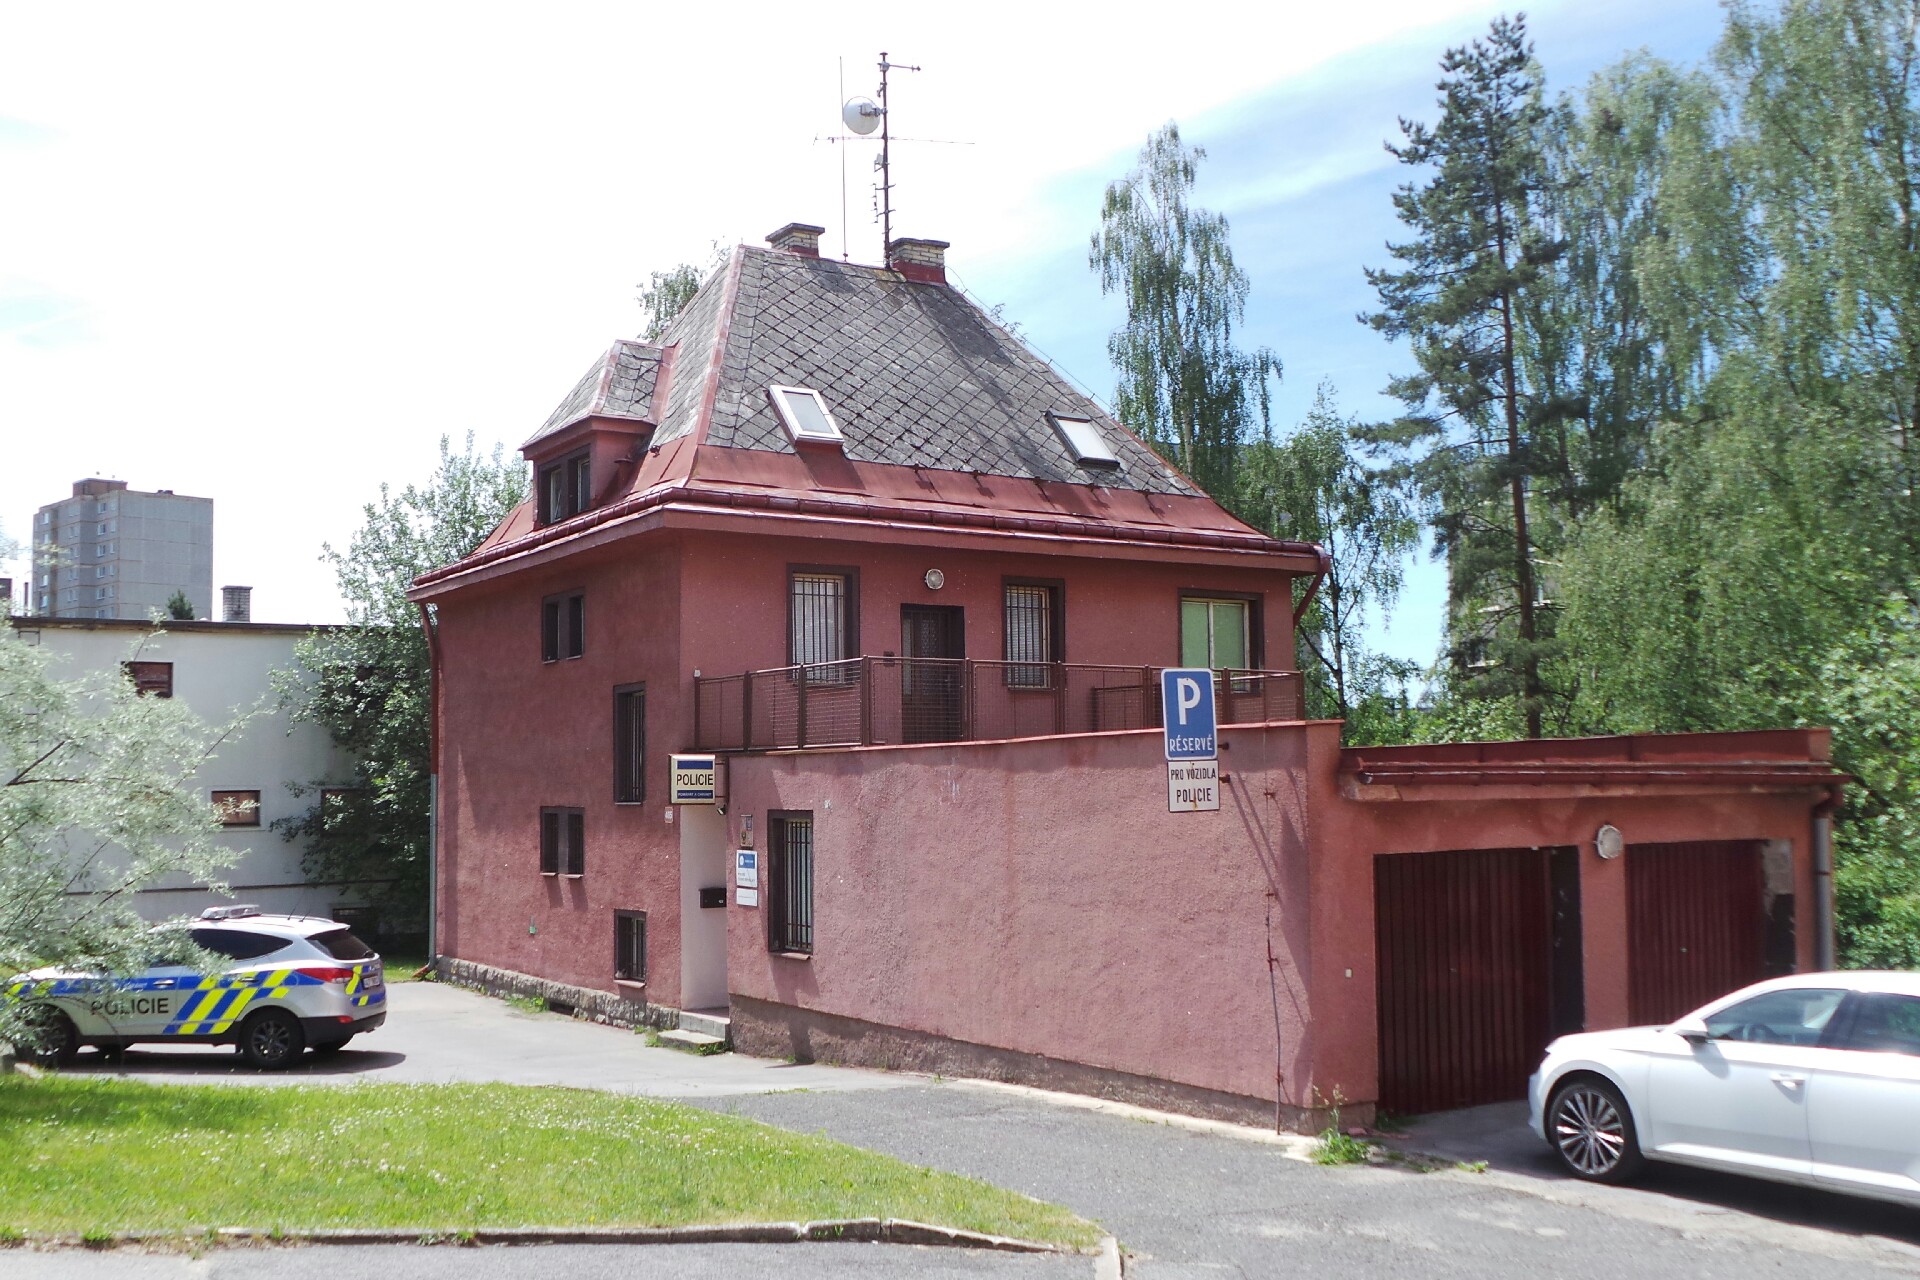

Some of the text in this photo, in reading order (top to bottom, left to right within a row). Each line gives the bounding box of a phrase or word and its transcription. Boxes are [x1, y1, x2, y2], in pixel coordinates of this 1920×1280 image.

[1177, 677, 1201, 725] P
[1169, 734, 1213, 752] RÉSERVÉ
[676, 773, 714, 786] POLICIE
[1170, 767, 1217, 781] PRO VOZIDLA
[1176, 788, 1212, 803] POLICIE
[90, 997, 169, 1016] POLICIE
